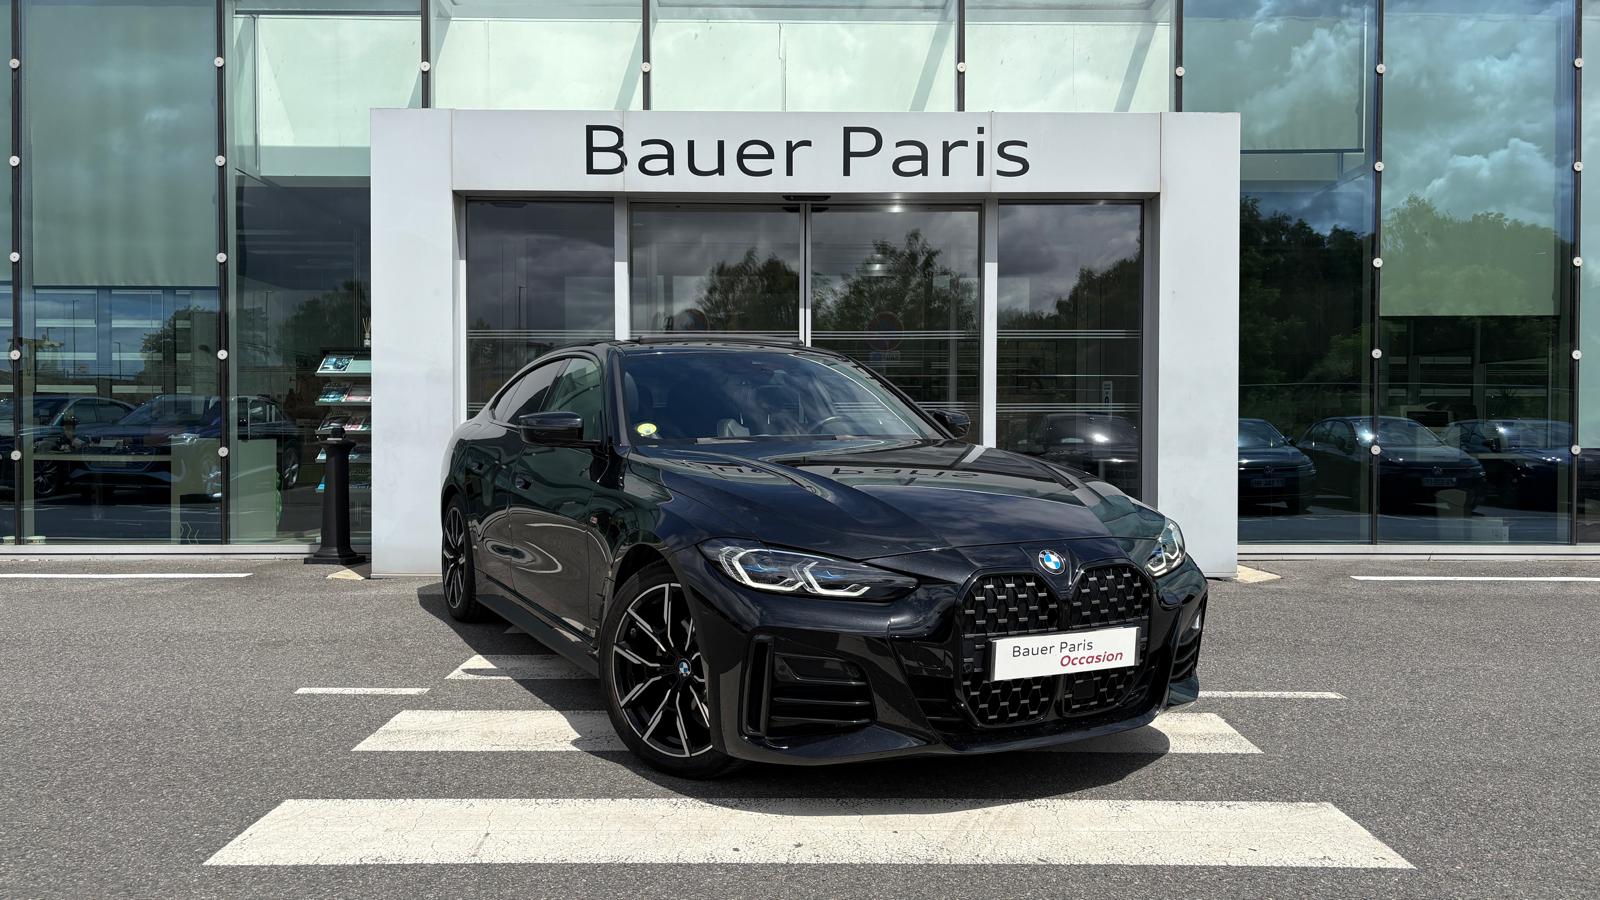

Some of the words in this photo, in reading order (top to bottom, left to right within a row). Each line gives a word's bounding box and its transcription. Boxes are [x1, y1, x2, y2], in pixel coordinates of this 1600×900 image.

[585, 124, 811, 177] Bauer
[842, 126, 1030, 177] Paris
[1012, 644, 1055, 658] Bauer
[1059, 639, 1093, 653] Paris
[1060, 650, 1124, 667] Occasion
